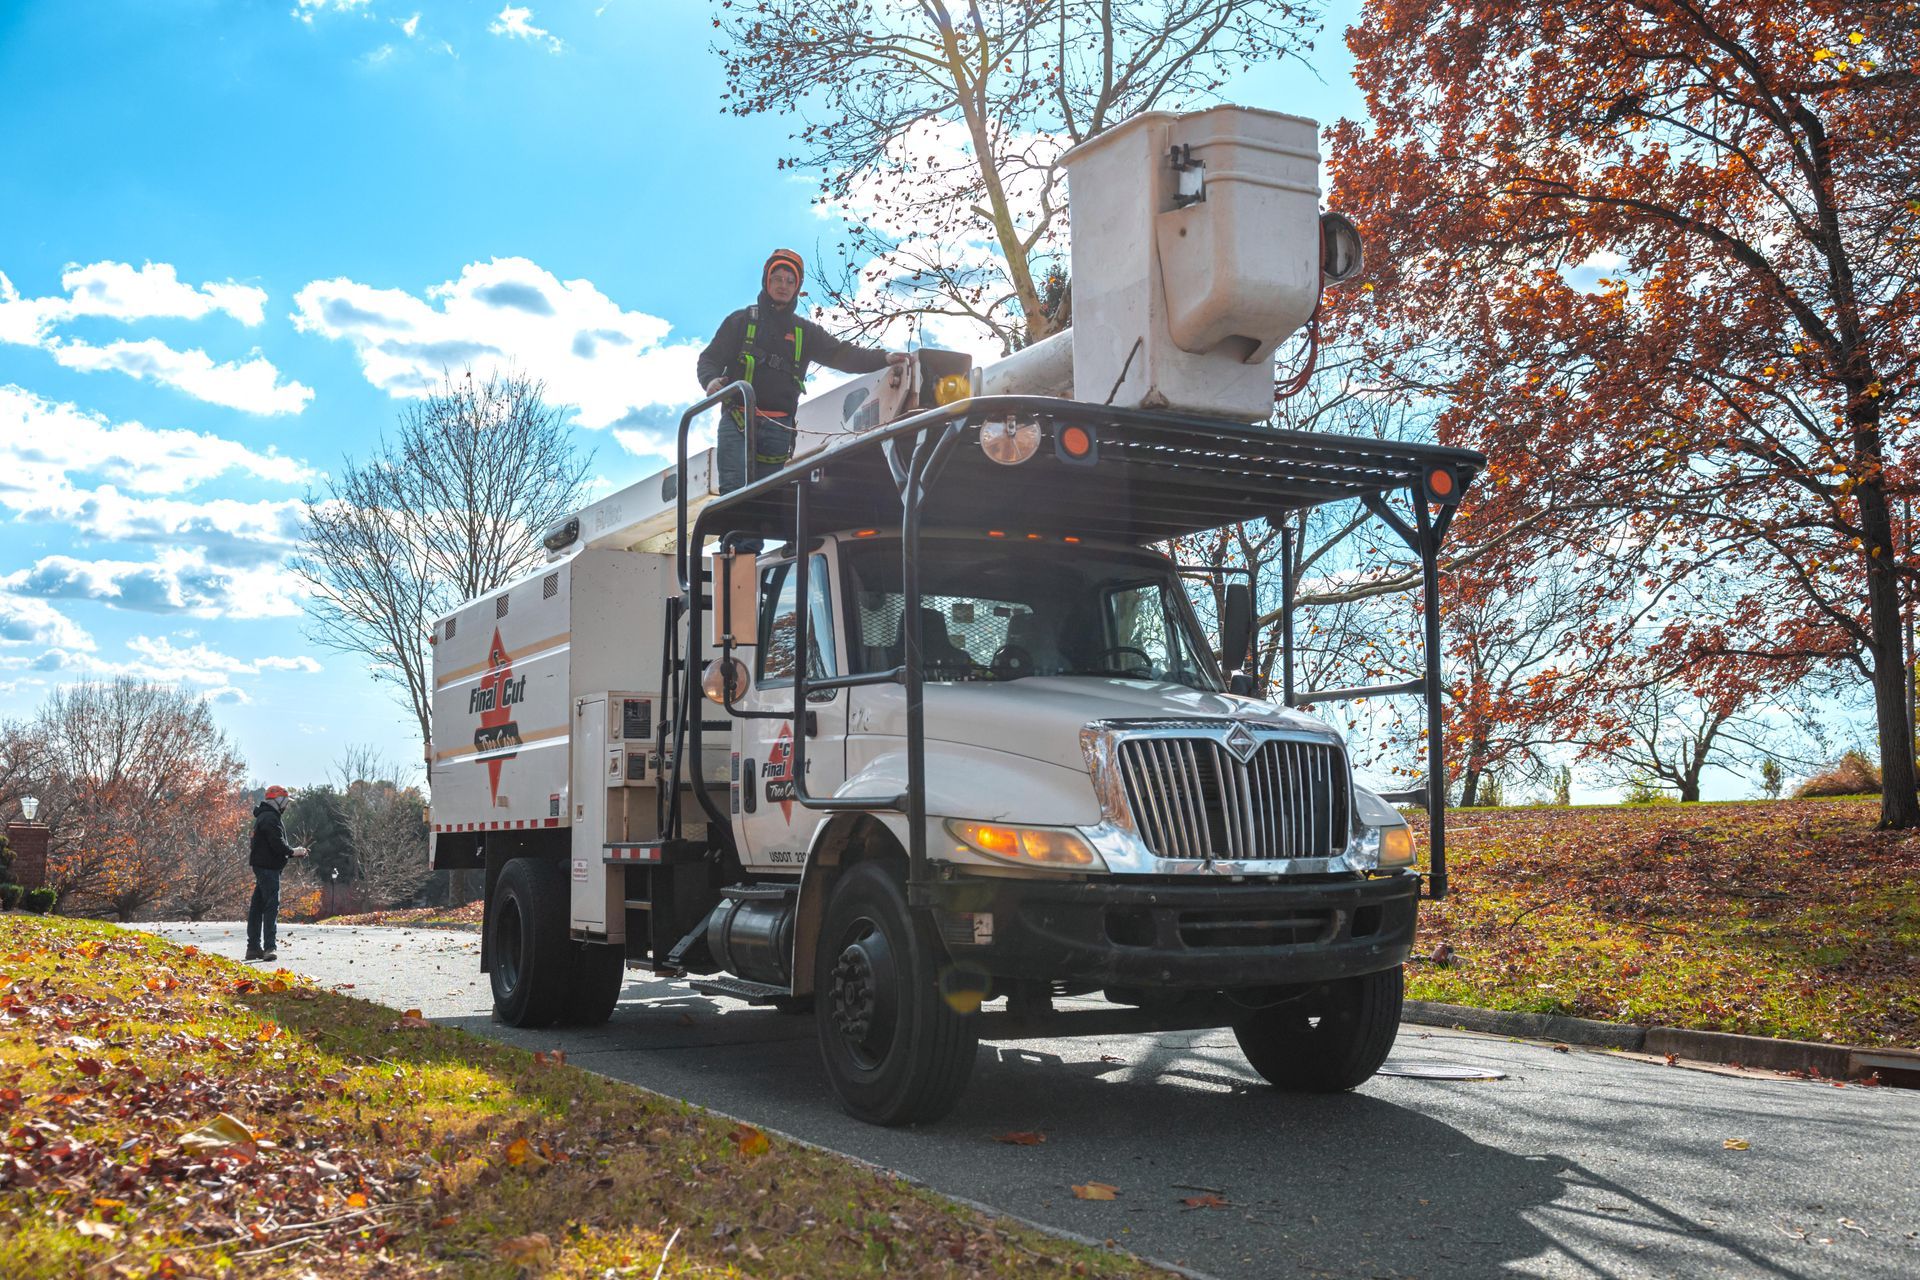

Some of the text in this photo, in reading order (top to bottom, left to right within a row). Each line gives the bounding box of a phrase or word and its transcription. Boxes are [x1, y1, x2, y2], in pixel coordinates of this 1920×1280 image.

[469, 674, 526, 714] Final Cut
[761, 761, 786, 778] Final
[770, 782, 797, 798] Tree Ca
[769, 851, 792, 862] USDOT
